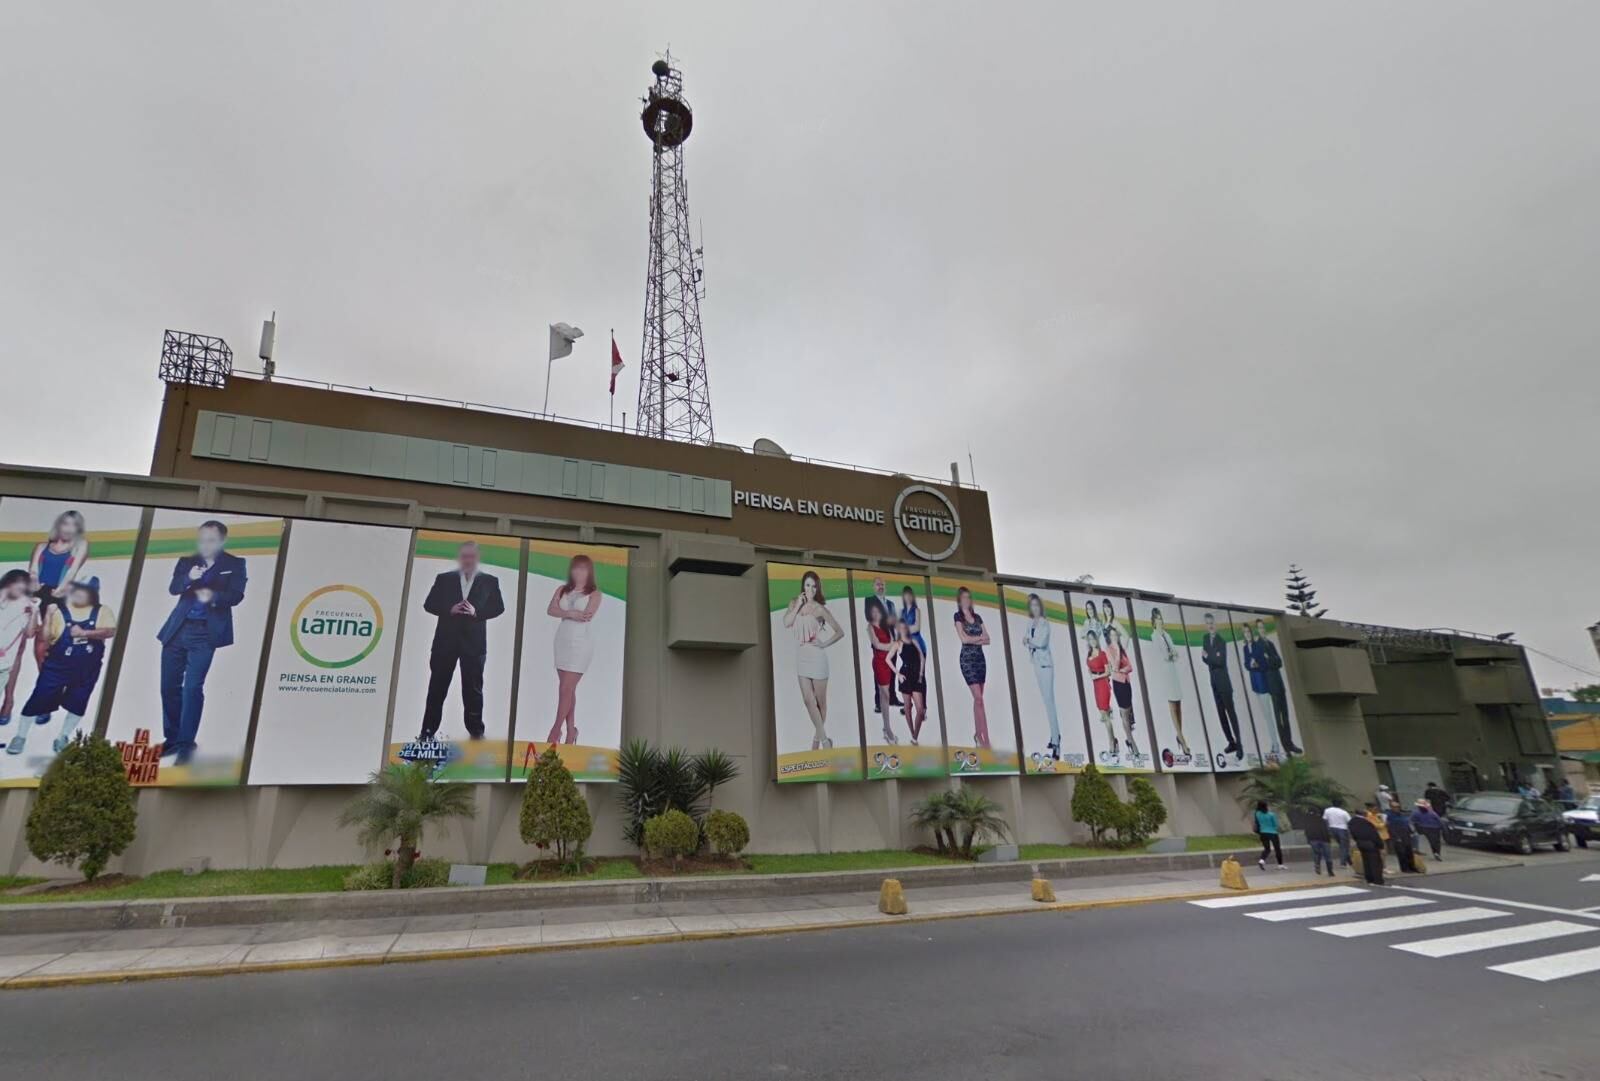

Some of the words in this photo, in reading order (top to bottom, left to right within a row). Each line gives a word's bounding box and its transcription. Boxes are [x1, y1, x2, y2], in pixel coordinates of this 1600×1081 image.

[734, 490, 794, 512] PIENSA
[797, 499, 819, 515] EN
[822, 503, 885, 524] GRANDE
[315, 610, 363, 618] FRECUENCIA
[280, 673, 318, 683] PIENSA
[320, 674, 334, 684] EN
[336, 675, 377, 685] GRANDE
[278, 685, 377, 694] www.frecuencialatina.com
[134, 728, 150, 744] LA
